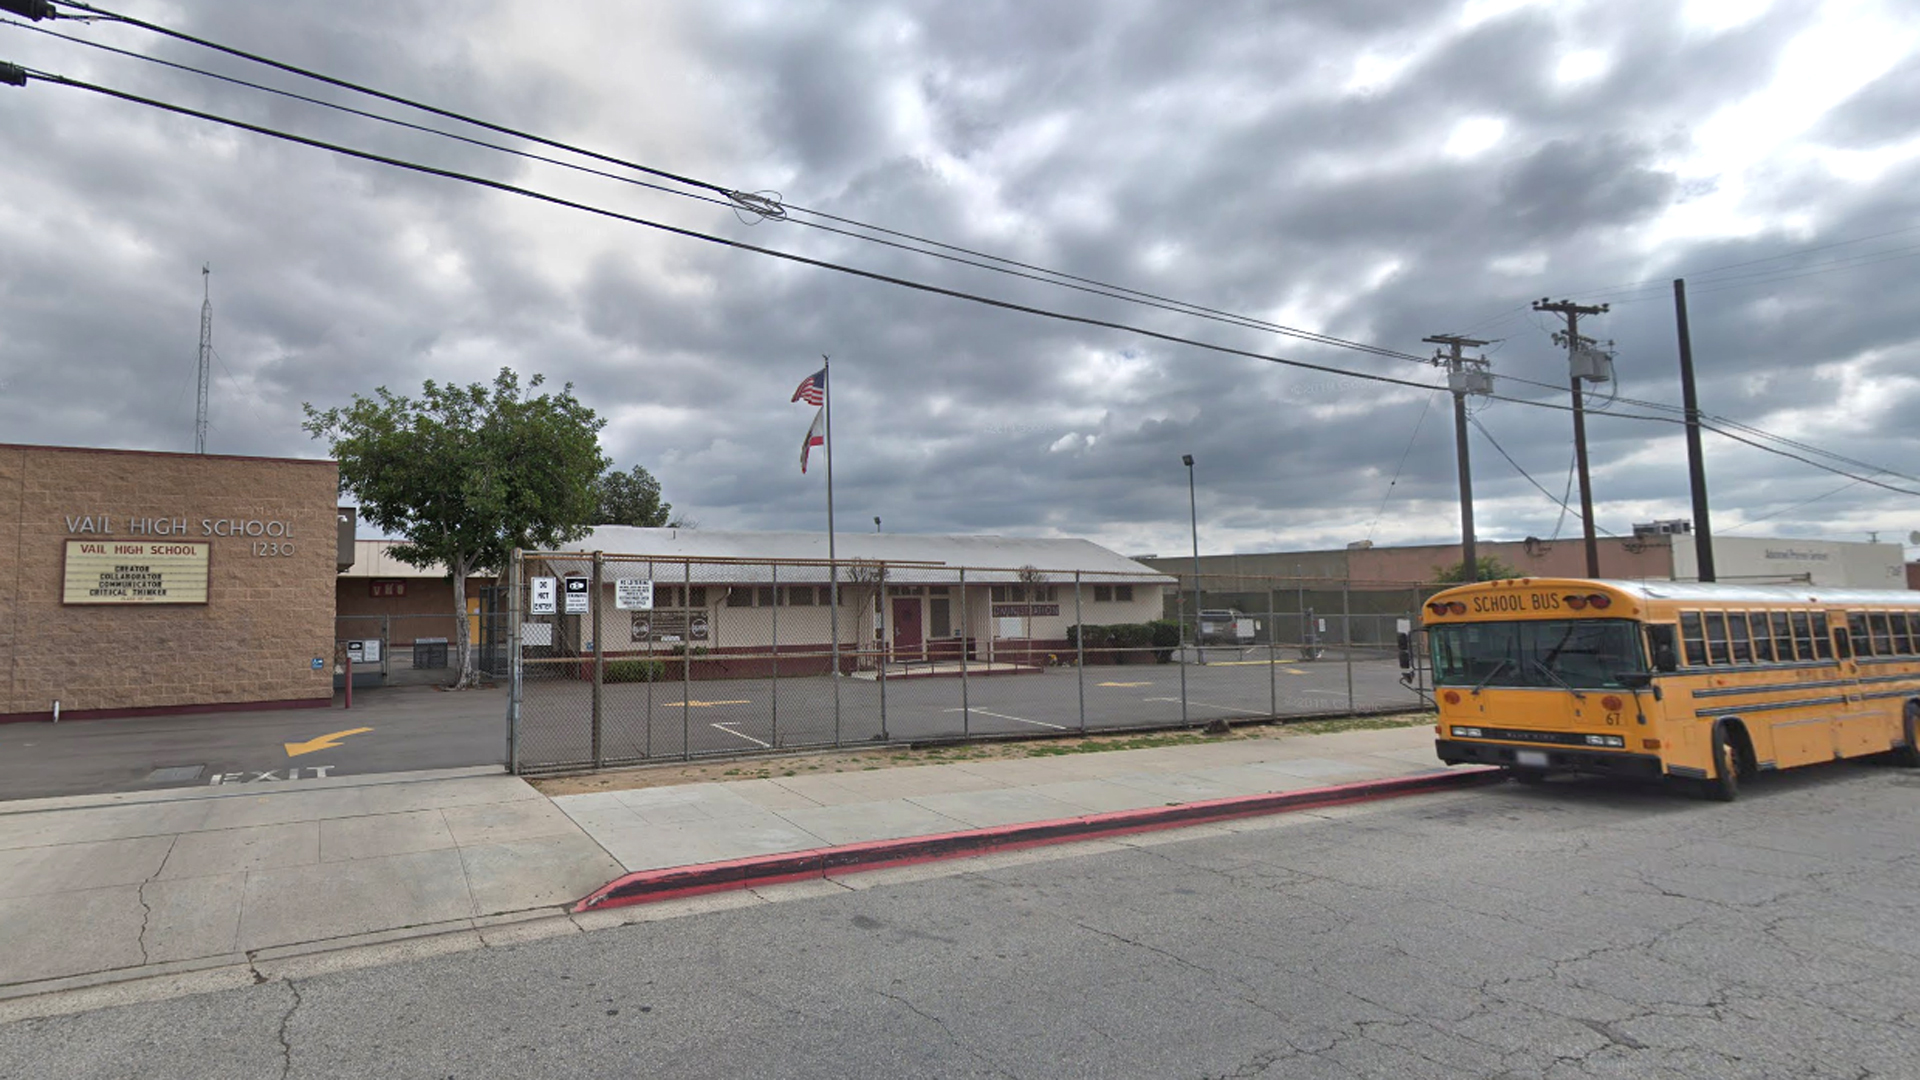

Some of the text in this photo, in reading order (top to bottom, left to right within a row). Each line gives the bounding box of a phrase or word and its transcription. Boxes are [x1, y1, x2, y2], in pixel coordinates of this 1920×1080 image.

[65, 515, 294, 538] VAIL HIGH SCHOOL
[80, 544, 197, 556] VAIL HIGH SCHOOL
[252, 541, 295, 557] 1230
[114, 565, 150, 573] CREATOR
[1473, 592, 1560, 613] SCHOOL BUS
[1605, 713, 1621, 726] 67
[210, 765, 336, 785] EXIT
